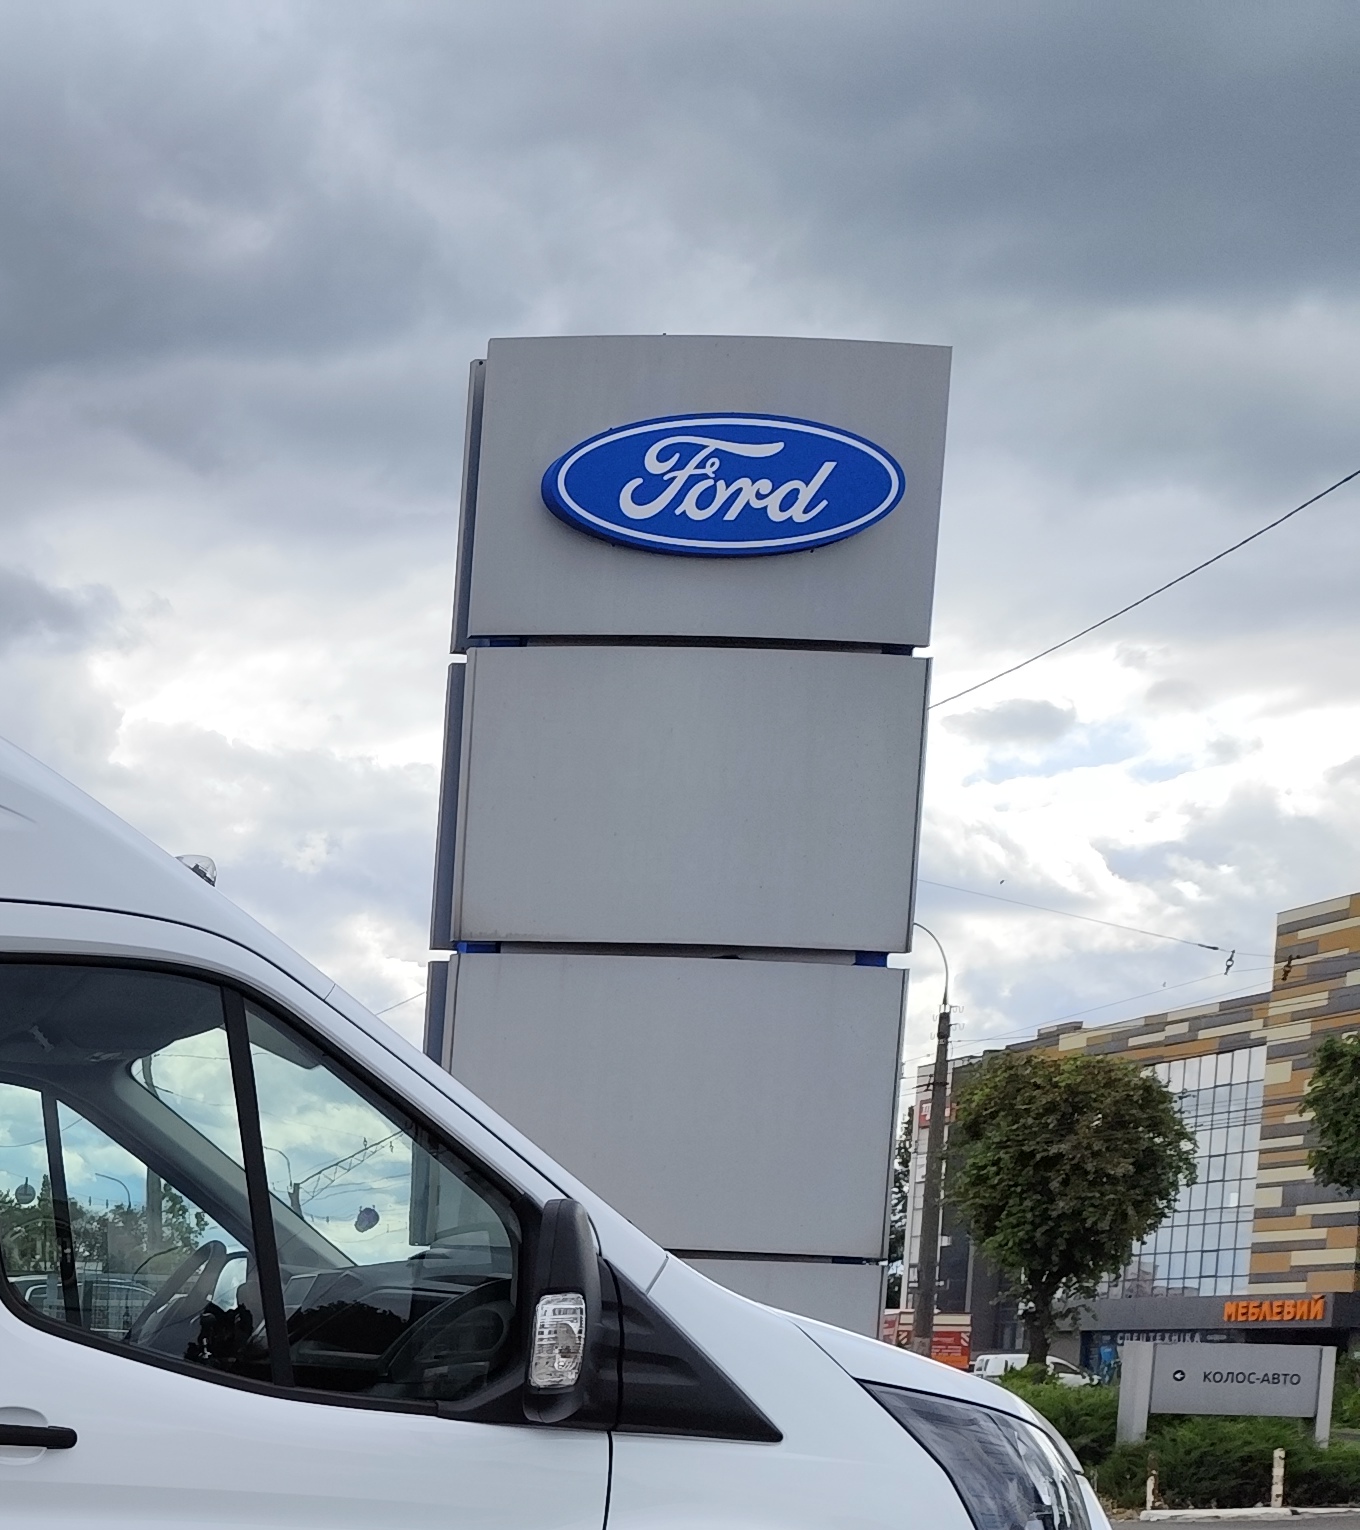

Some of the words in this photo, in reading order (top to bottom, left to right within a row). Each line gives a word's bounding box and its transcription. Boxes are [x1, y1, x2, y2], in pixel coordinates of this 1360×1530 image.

[619, 435, 837, 523] Ford
[1223, 1294, 1326, 1322] МЕБЛЕВИЙ
[1203, 1371, 1301, 1386] КОЛОС-АВТО
